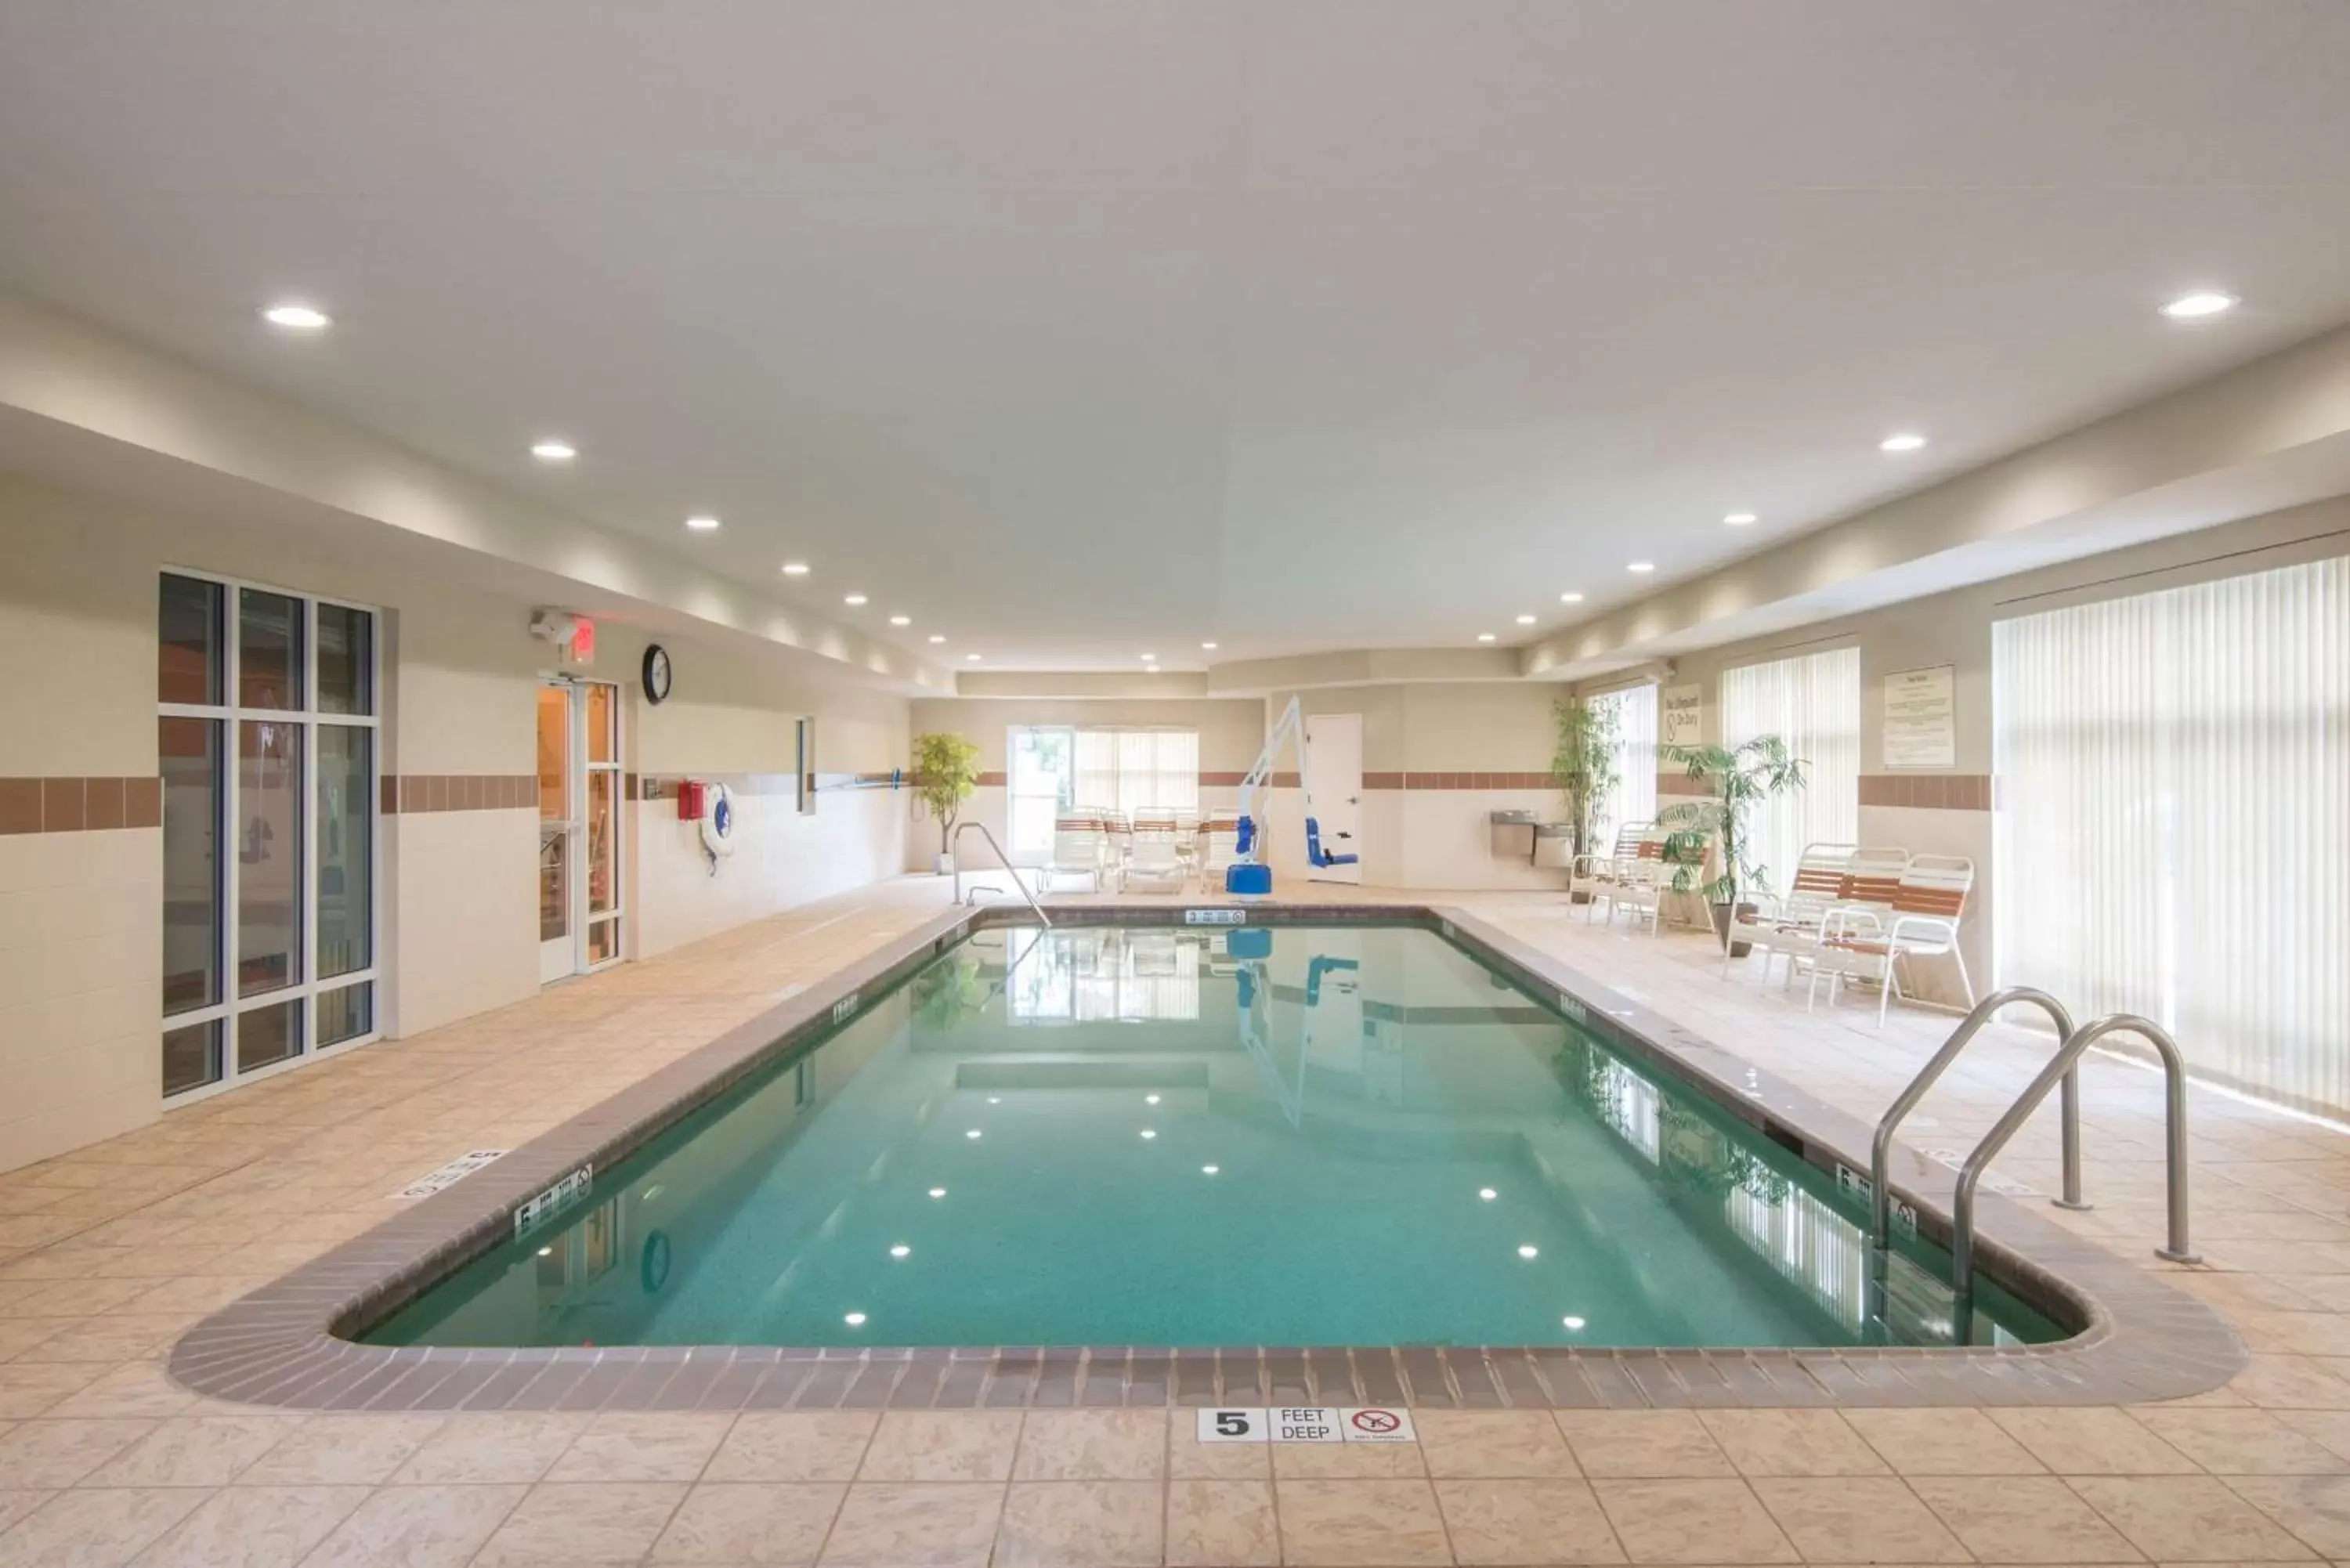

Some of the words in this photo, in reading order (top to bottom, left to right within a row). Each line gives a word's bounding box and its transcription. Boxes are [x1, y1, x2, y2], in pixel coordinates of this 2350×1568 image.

[1282, 1409, 1325, 1422] FEET
[1216, 1412, 1249, 1436] 5
[1282, 1426, 1329, 1439] DEEP
